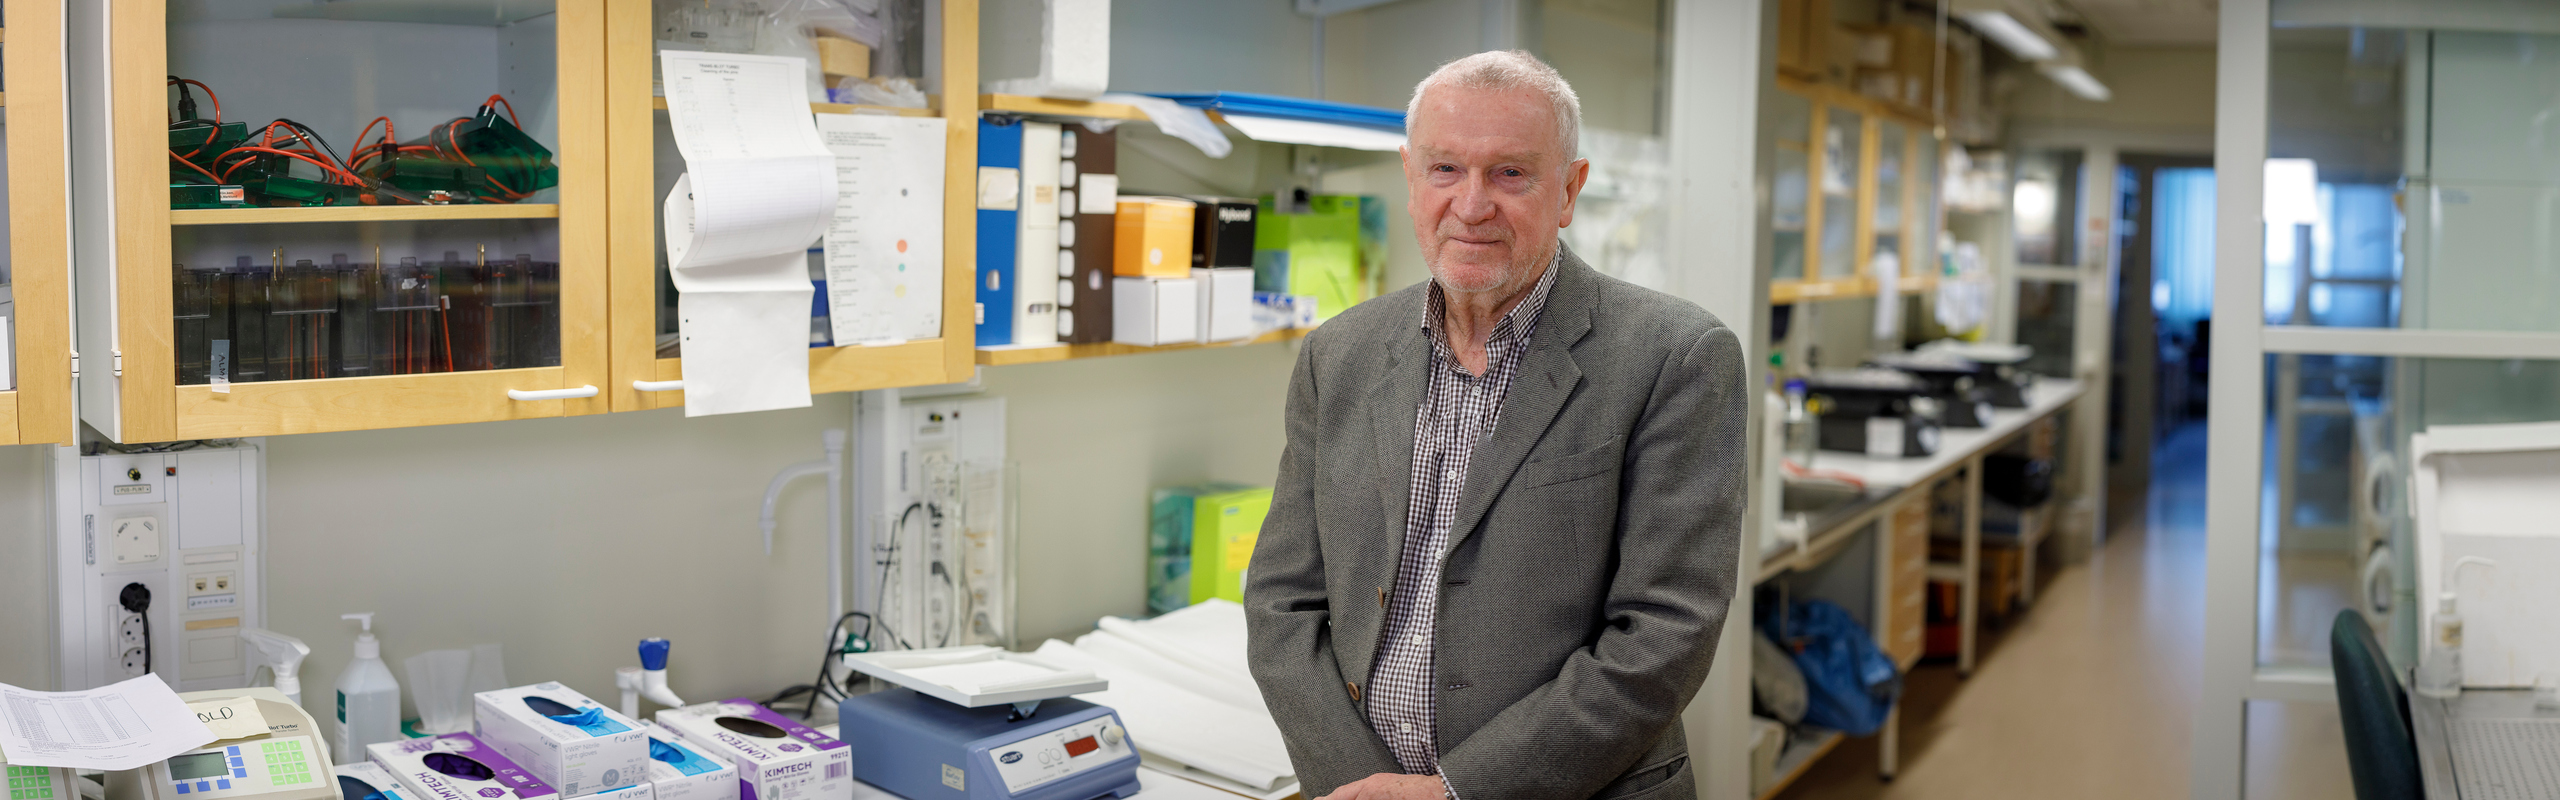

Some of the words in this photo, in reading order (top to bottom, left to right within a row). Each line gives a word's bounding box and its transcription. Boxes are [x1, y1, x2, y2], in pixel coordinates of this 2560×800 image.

[1219, 207, 1252, 223] Hybond
[197, 706, 233, 723] OLD
[582, 742, 600, 750] Nitrile
[713, 731, 771, 760] KIMTECH
[580, 750, 598, 759] gloves
[830, 751, 848, 760] 99212
[1001, 751, 1022, 764] stuart
[764, 761, 812, 778] KIMTECH
[606, 772, 615, 782] M
[415, 771, 461, 800] IMTECH
